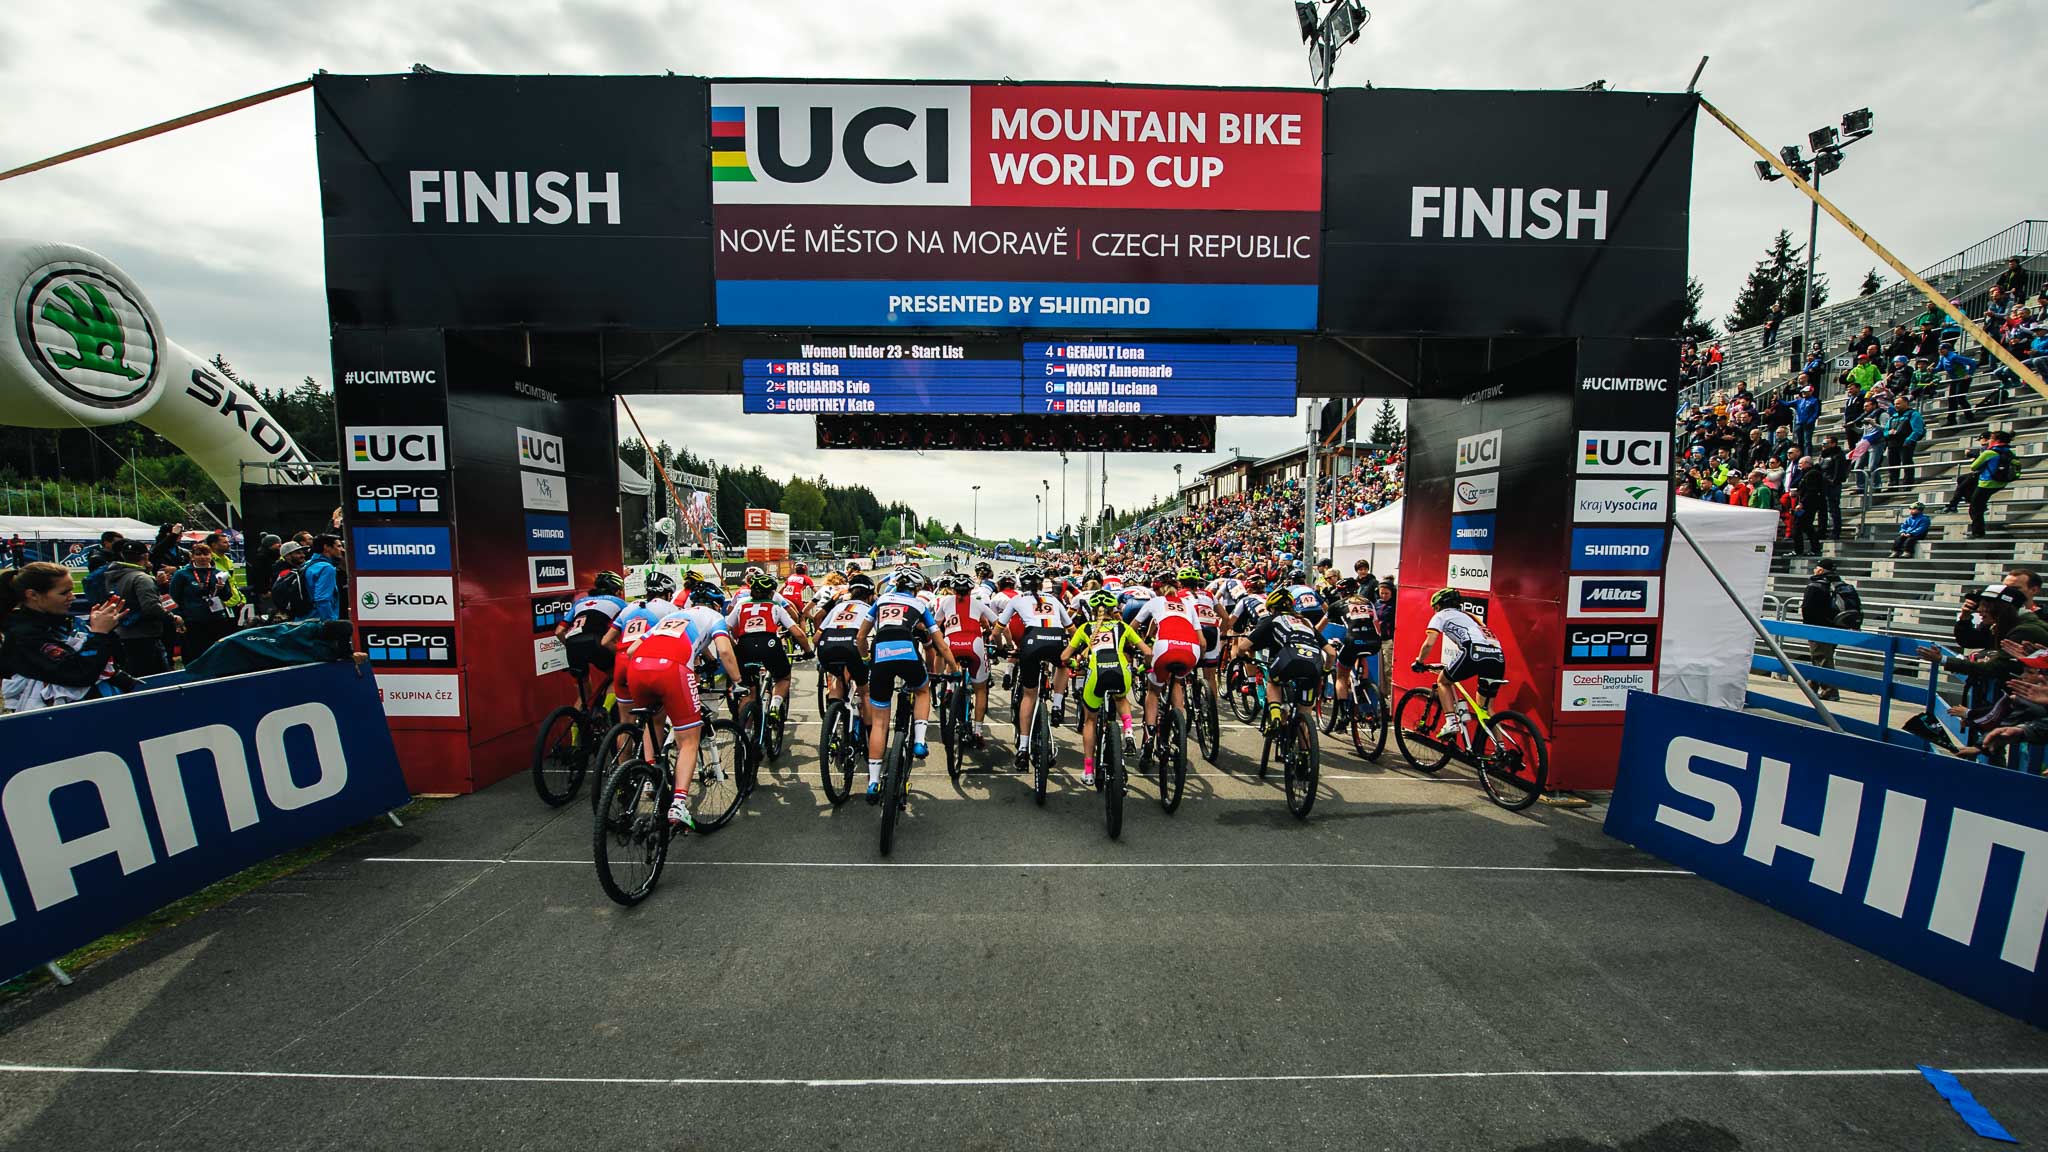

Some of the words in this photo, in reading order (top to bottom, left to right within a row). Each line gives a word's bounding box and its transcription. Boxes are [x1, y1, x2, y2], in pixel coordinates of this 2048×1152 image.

[990, 108, 1212, 145] MOUNTAIN
[1220, 112, 1302, 146] BIKE
[756, 106, 949, 184] UCI
[990, 152, 1136, 187] WORLD
[1146, 155, 1224, 188] CUP
[409, 170, 621, 225] FINISH
[1410, 186, 1608, 240] FINISH
[719, 224, 796, 254] NOVÉ
[804, 224, 898, 254] MĚSTO
[906, 231, 944, 255] NA
[952, 226, 1068, 256] MORAVĚ
[1091, 233, 1179, 258] CZECH
[1188, 235, 1311, 260] REPUBLIC
[888, 295, 1003, 314] PRESENTED
[1008, 296, 1033, 314] BY
[1039, 297, 1150, 315] SHIMANO
[801, 345, 847, 358] Women
[849, 345, 885, 358] Under
[887, 345, 902, 358] 23
[912, 345, 946, 359] Start
[948, 345, 964, 359] List
[1045, 346, 1053, 358] 4
[1066, 345, 1115, 360] GERAULT
[1116, 346, 1145, 360] Lena
[766, 362, 773, 374] 1
[786, 362, 811, 376] FREI
[812, 362, 839, 376] Sina
[1045, 363, 1054, 376] 5
[1066, 364, 1107, 377] WORST
[1109, 364, 1173, 378] Annemarie
[344, 371, 436, 385] #UCIMTBWC
[1582, 377, 1667, 392] #UCIMTBWC
[515, 381, 558, 404] #UCIMTBWC
[766, 380, 774, 393] 2
[787, 380, 845, 394] RICHARDS
[846, 380, 870, 394] Evie
[1045, 381, 1053, 394] 6
[1066, 381, 1110, 395] ROLAND
[1111, 382, 1158, 396] Luciana
[1461, 383, 1504, 407] #UCIMTBWC
[767, 398, 774, 410] 3
[787, 398, 846, 412] COURTNEY
[847, 398, 875, 412] Kate
[1046, 399, 1053, 411] 7
[1066, 399, 1095, 413] DEGN
[1097, 399, 1141, 413] Malene
[369, 434, 437, 462] UCI
[528, 437, 561, 464] UCI
[1466, 437, 1498, 464] UCI
[1600, 439, 1662, 466] UCI
[356, 485, 439, 498] GoPro
[1580, 500, 1603, 513] Kraj
[532, 528, 564, 539] SHIMANO
[1456, 528, 1488, 538] SHIMANO
[368, 544, 436, 555] SHIMANO
[1585, 545, 1649, 556] SHIMANO
[539, 566, 566, 577] Mitas
[1460, 567, 1489, 578] ŠKODA
[385, 593, 448, 606] ŠKODA
[1587, 588, 1642, 600] Mitas
[535, 601, 573, 615] GoPro
[882, 608, 900, 618] 59
[1035, 604, 1052, 614] 49
[1168, 603, 1184, 611] 55
[1200, 608, 1214, 618] 46
[627, 621, 641, 633] 61
[661, 620, 685, 630] 57
[748, 617, 763, 627] 52
[367, 634, 447, 647] GoPro
[1572, 631, 1648, 644] GoPro
[389, 691, 432, 700] SKUPINA
[435, 689, 453, 700] ČEZ
[686, 673, 701, 713] RUSSIA
[0, 702, 348, 927] ANO
